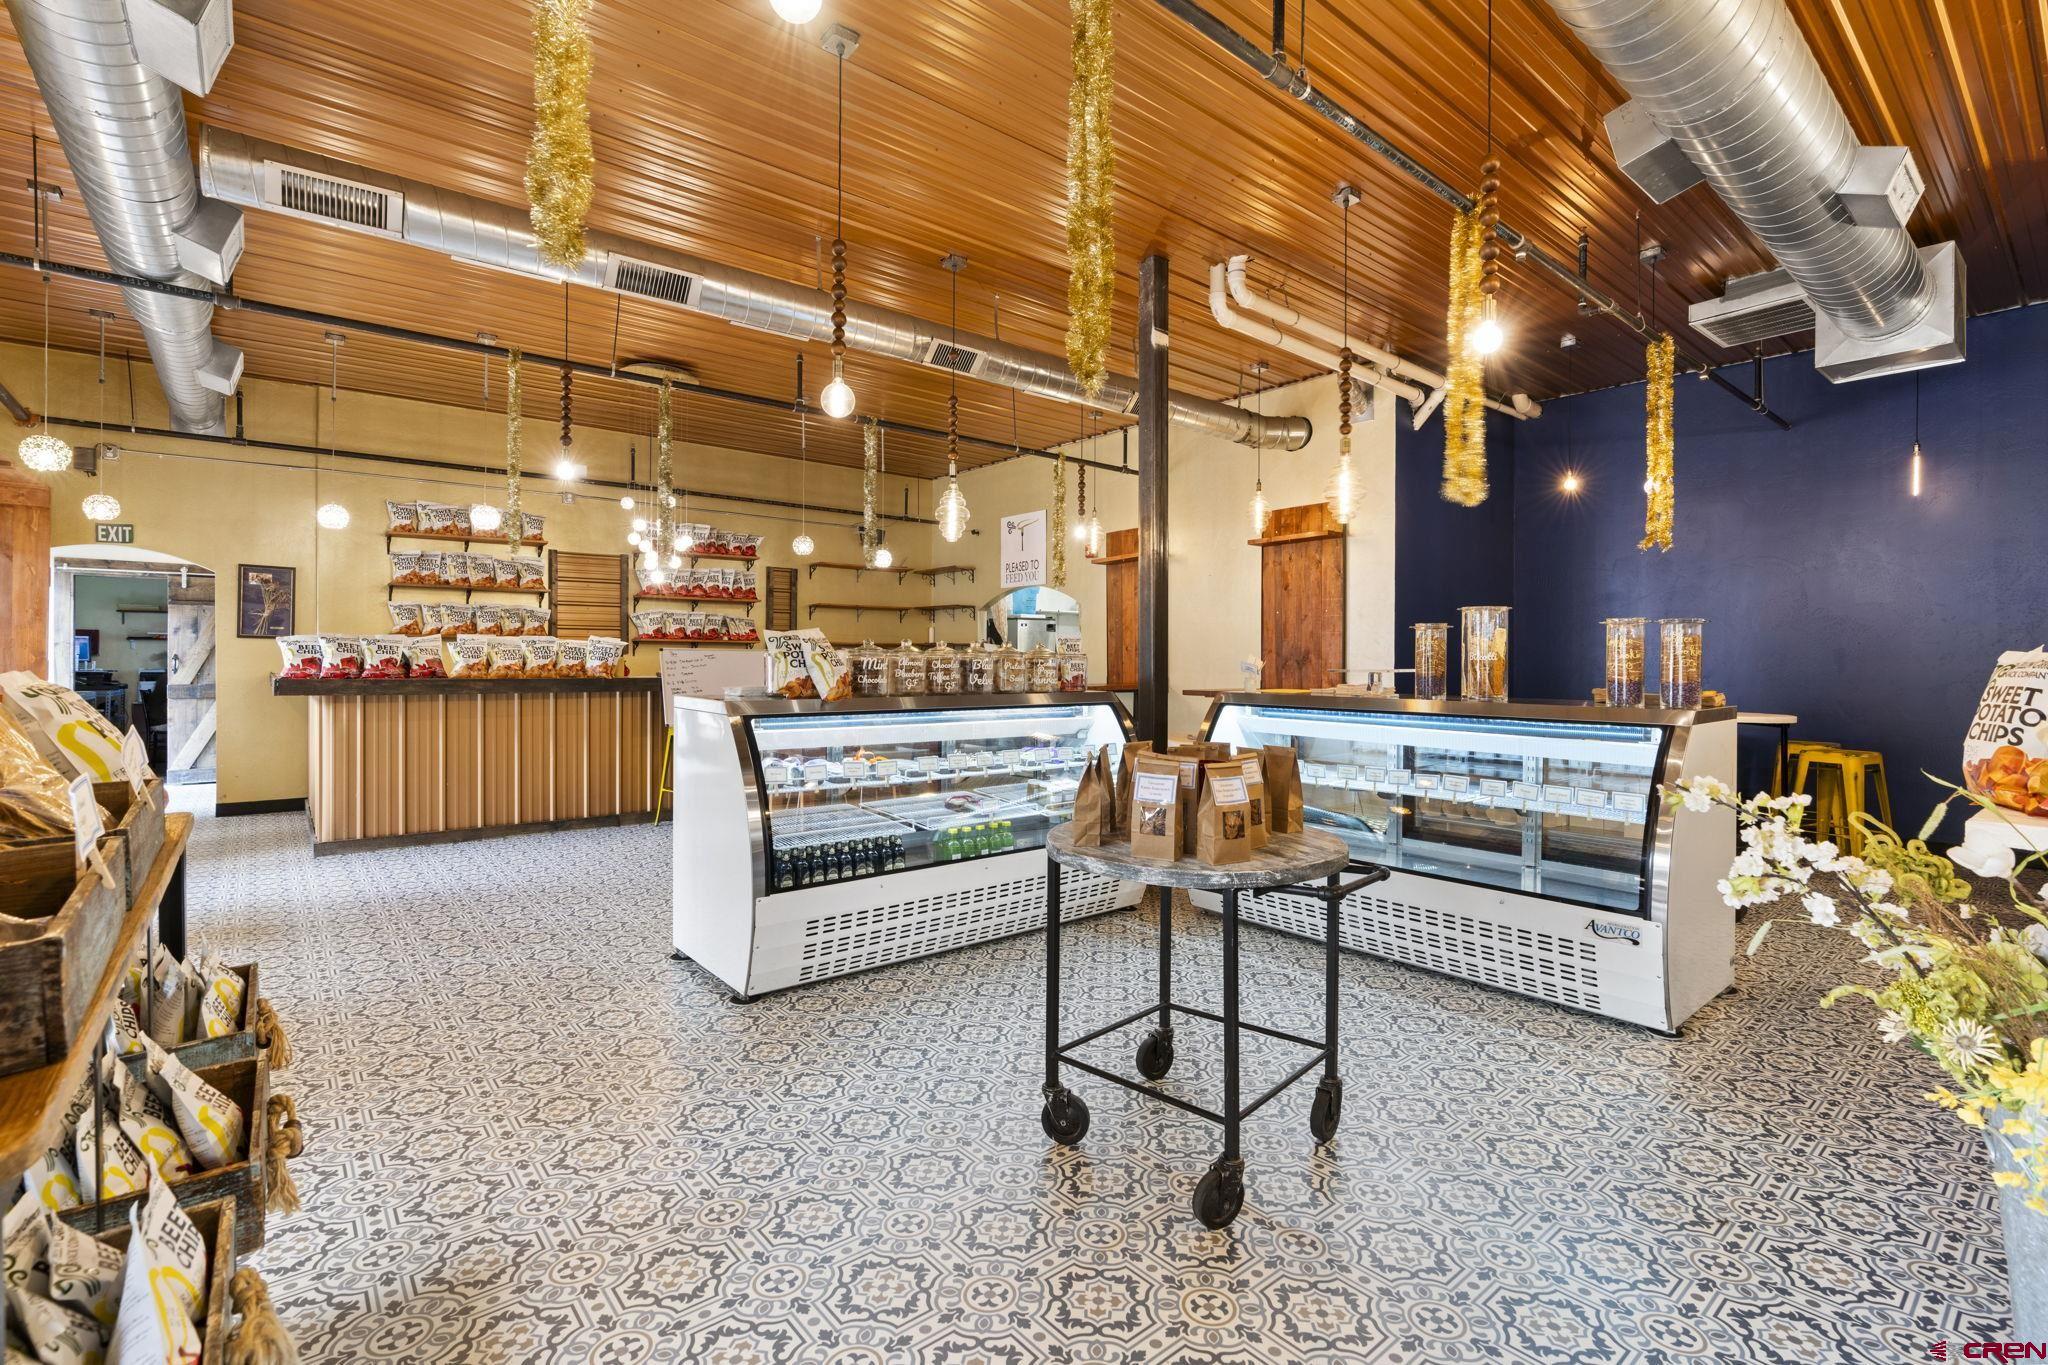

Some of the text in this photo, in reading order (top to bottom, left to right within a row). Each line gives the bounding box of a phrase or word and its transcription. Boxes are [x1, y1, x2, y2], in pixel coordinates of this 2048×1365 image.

[97, 525, 132, 543] EXIT
[1005, 559, 1040, 573] PLEASED TO
[1005, 570, 1040, 584] FEED YOU
[1982, 685, 2043, 707] SWEET
[1977, 703, 2047, 728] OTATO
[1968, 722, 2025, 746] CHIPS
